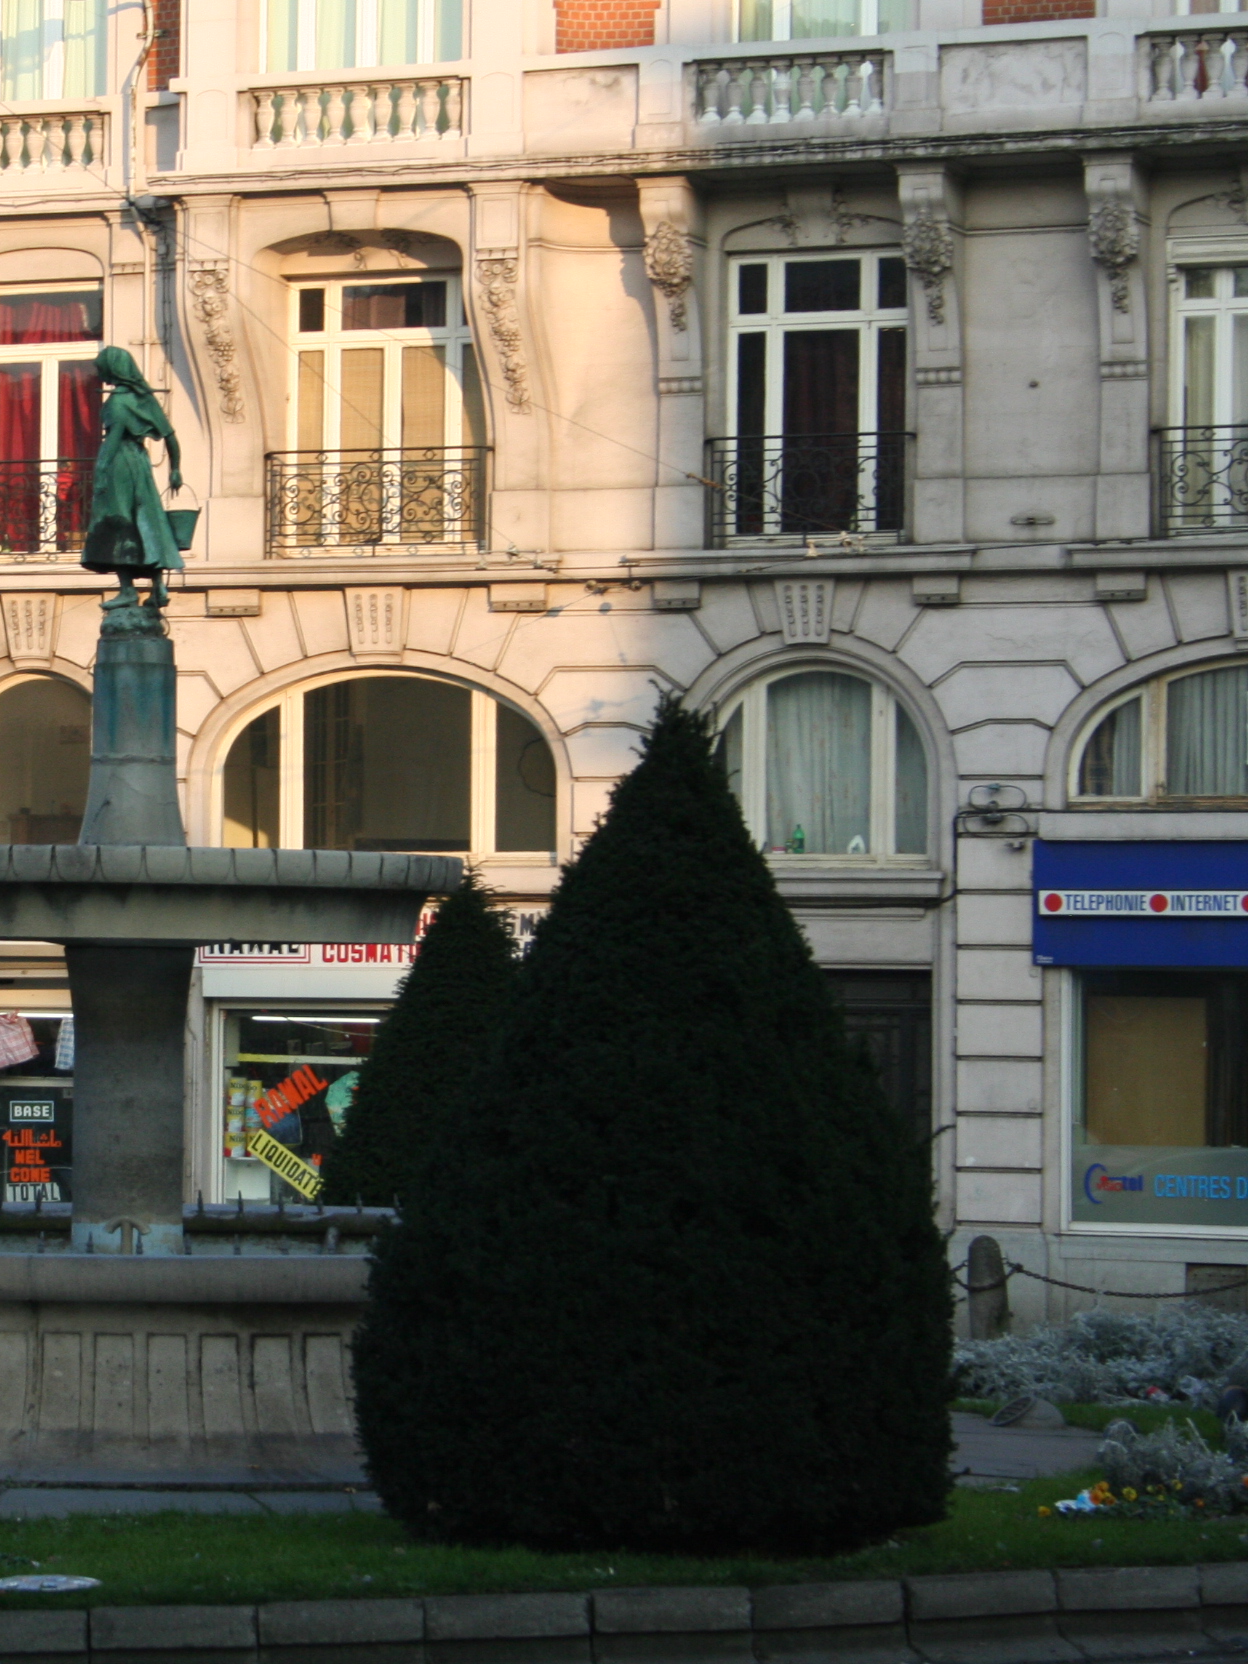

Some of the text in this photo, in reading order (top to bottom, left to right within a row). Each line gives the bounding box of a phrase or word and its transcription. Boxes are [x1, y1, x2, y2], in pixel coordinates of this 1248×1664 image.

[1064, 894, 1239, 911] TELEPHONIE INTERNET
[253, 1064, 329, 1128] RAWAL
[14, 1105, 50, 1117] BASE
[15, 1150, 45, 1165] WEL
[10, 1167, 50, 1182] COME
[9, 1184, 58, 1201] TOTAL
[1154, 1174, 1231, 1199] CENTRES
